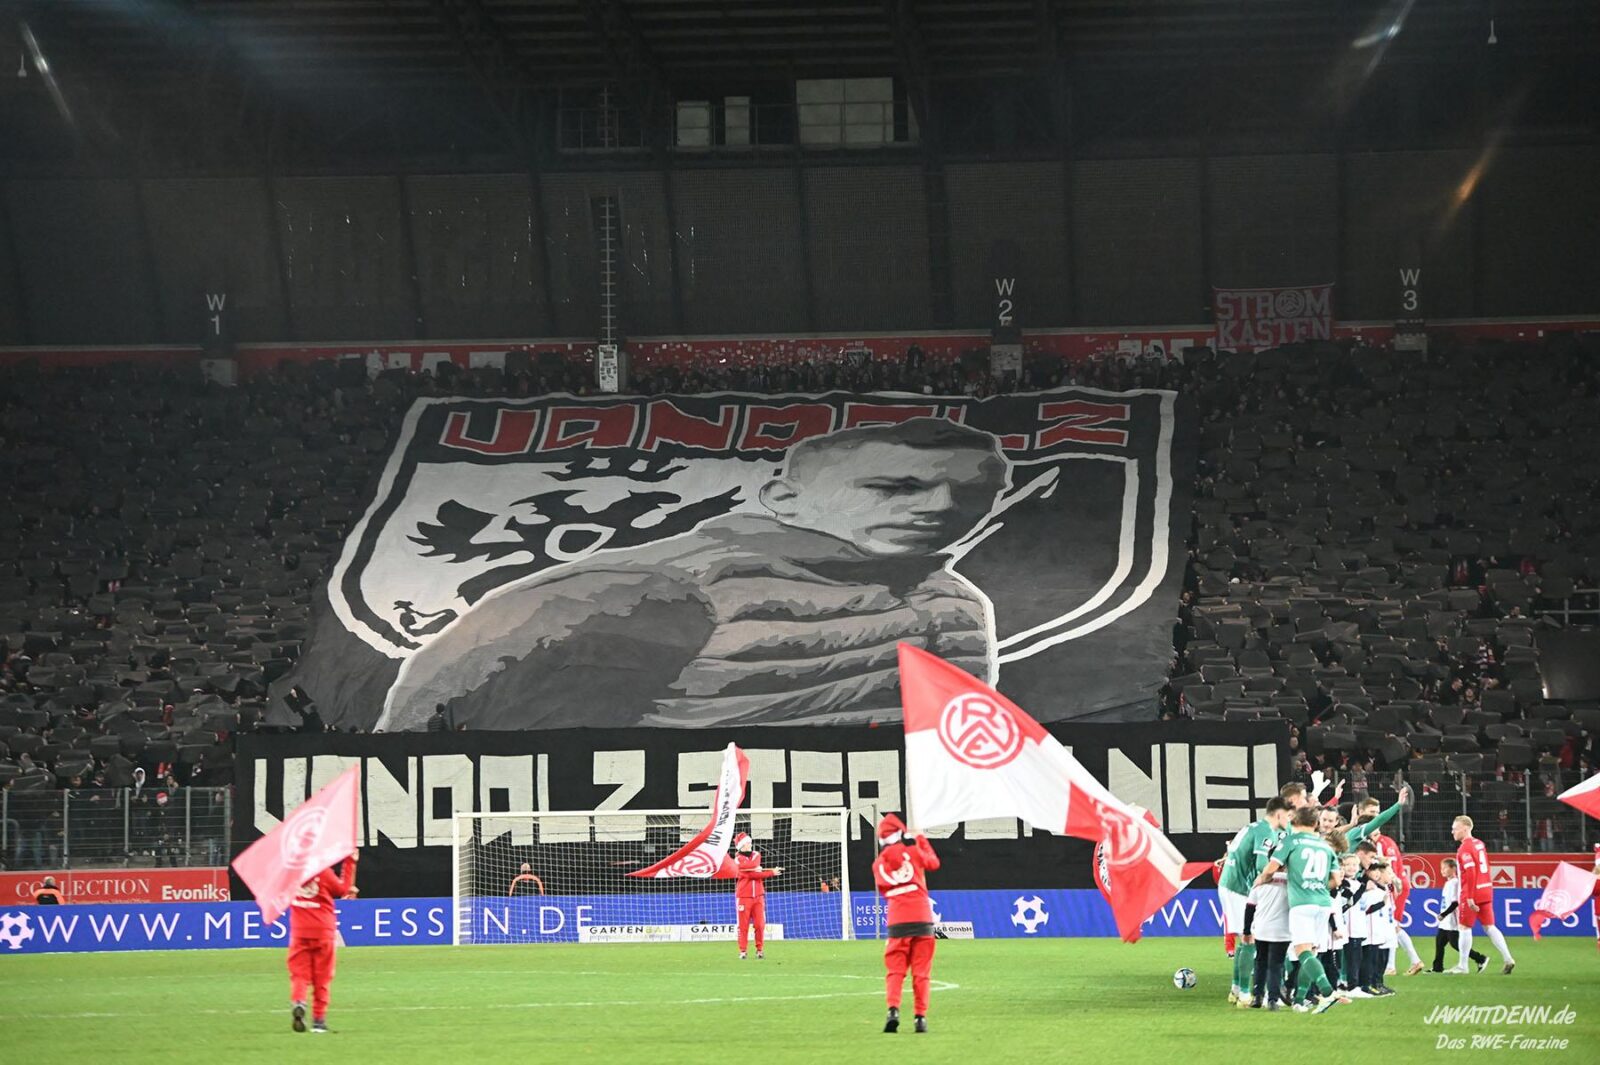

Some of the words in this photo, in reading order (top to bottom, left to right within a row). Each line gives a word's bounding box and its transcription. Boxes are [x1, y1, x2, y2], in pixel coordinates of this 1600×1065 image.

[995, 278, 1015, 296] W
[1400, 268, 1420, 286] W
[206, 294, 226, 311] W
[999, 300, 1013, 320] 2
[1403, 290, 1417, 310] 3
[211, 315, 219, 335] 1
[678, 745, 1073, 842] STER
[1301, 848, 1328, 881] 20
[15, 878, 150, 897] COLECTION
